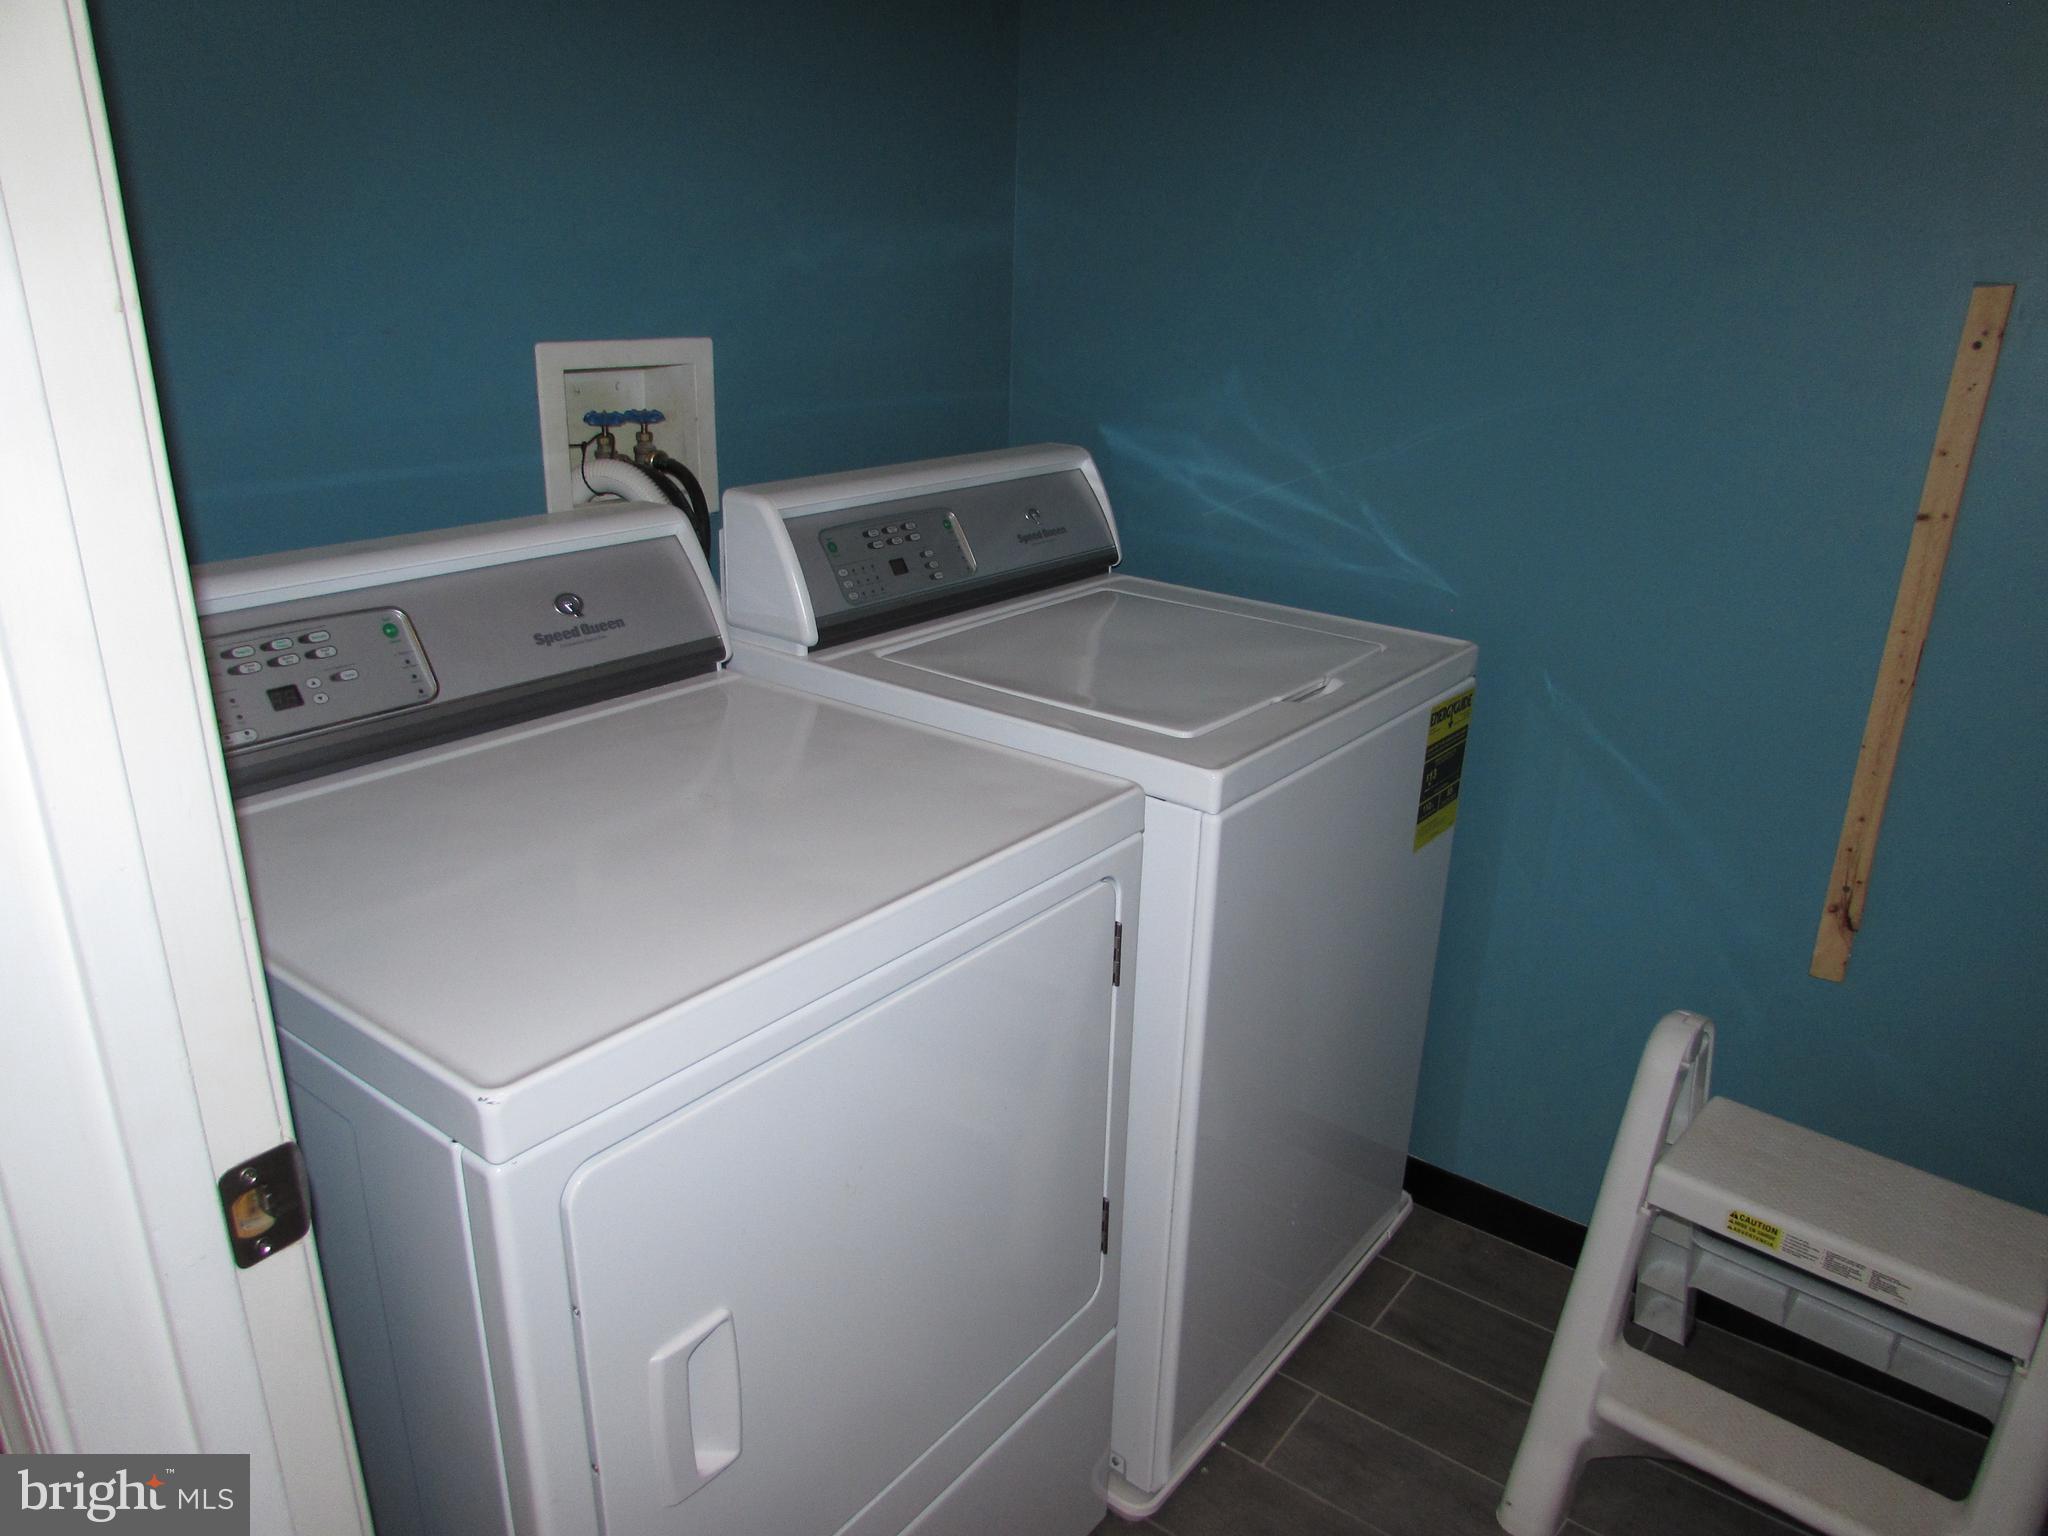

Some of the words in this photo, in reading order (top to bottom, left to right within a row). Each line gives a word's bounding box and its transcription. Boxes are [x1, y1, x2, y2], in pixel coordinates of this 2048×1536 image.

[1016, 529, 1042, 544] Speed
[533, 624, 581, 647] Speed
[581, 618, 625, 635] Queen
[1739, 1214, 1778, 1235] CAUTION
